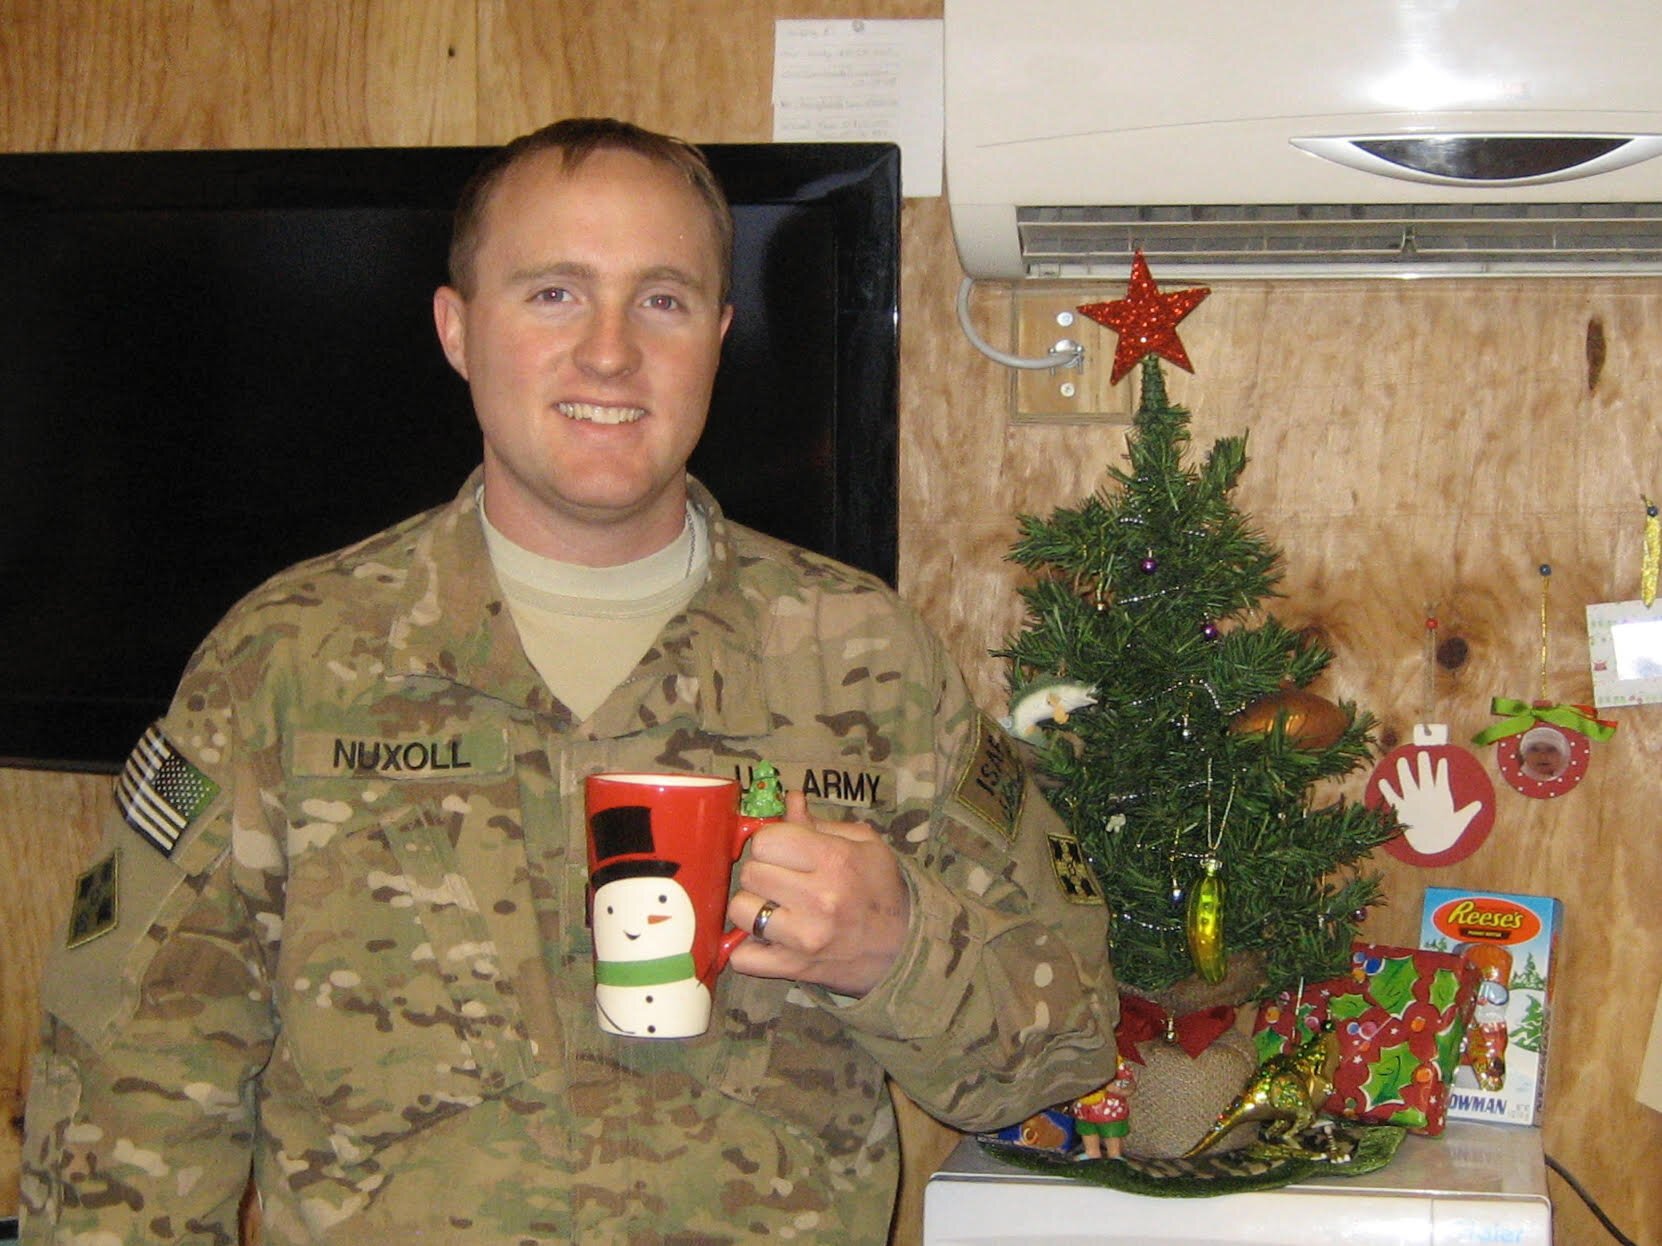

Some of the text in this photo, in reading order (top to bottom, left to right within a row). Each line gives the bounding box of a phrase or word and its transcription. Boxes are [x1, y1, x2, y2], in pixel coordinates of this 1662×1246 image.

[333, 738, 471, 771] NUXOLL
[802, 768, 880, 802] ARMY
[1448, 901, 1524, 929] Reese's
